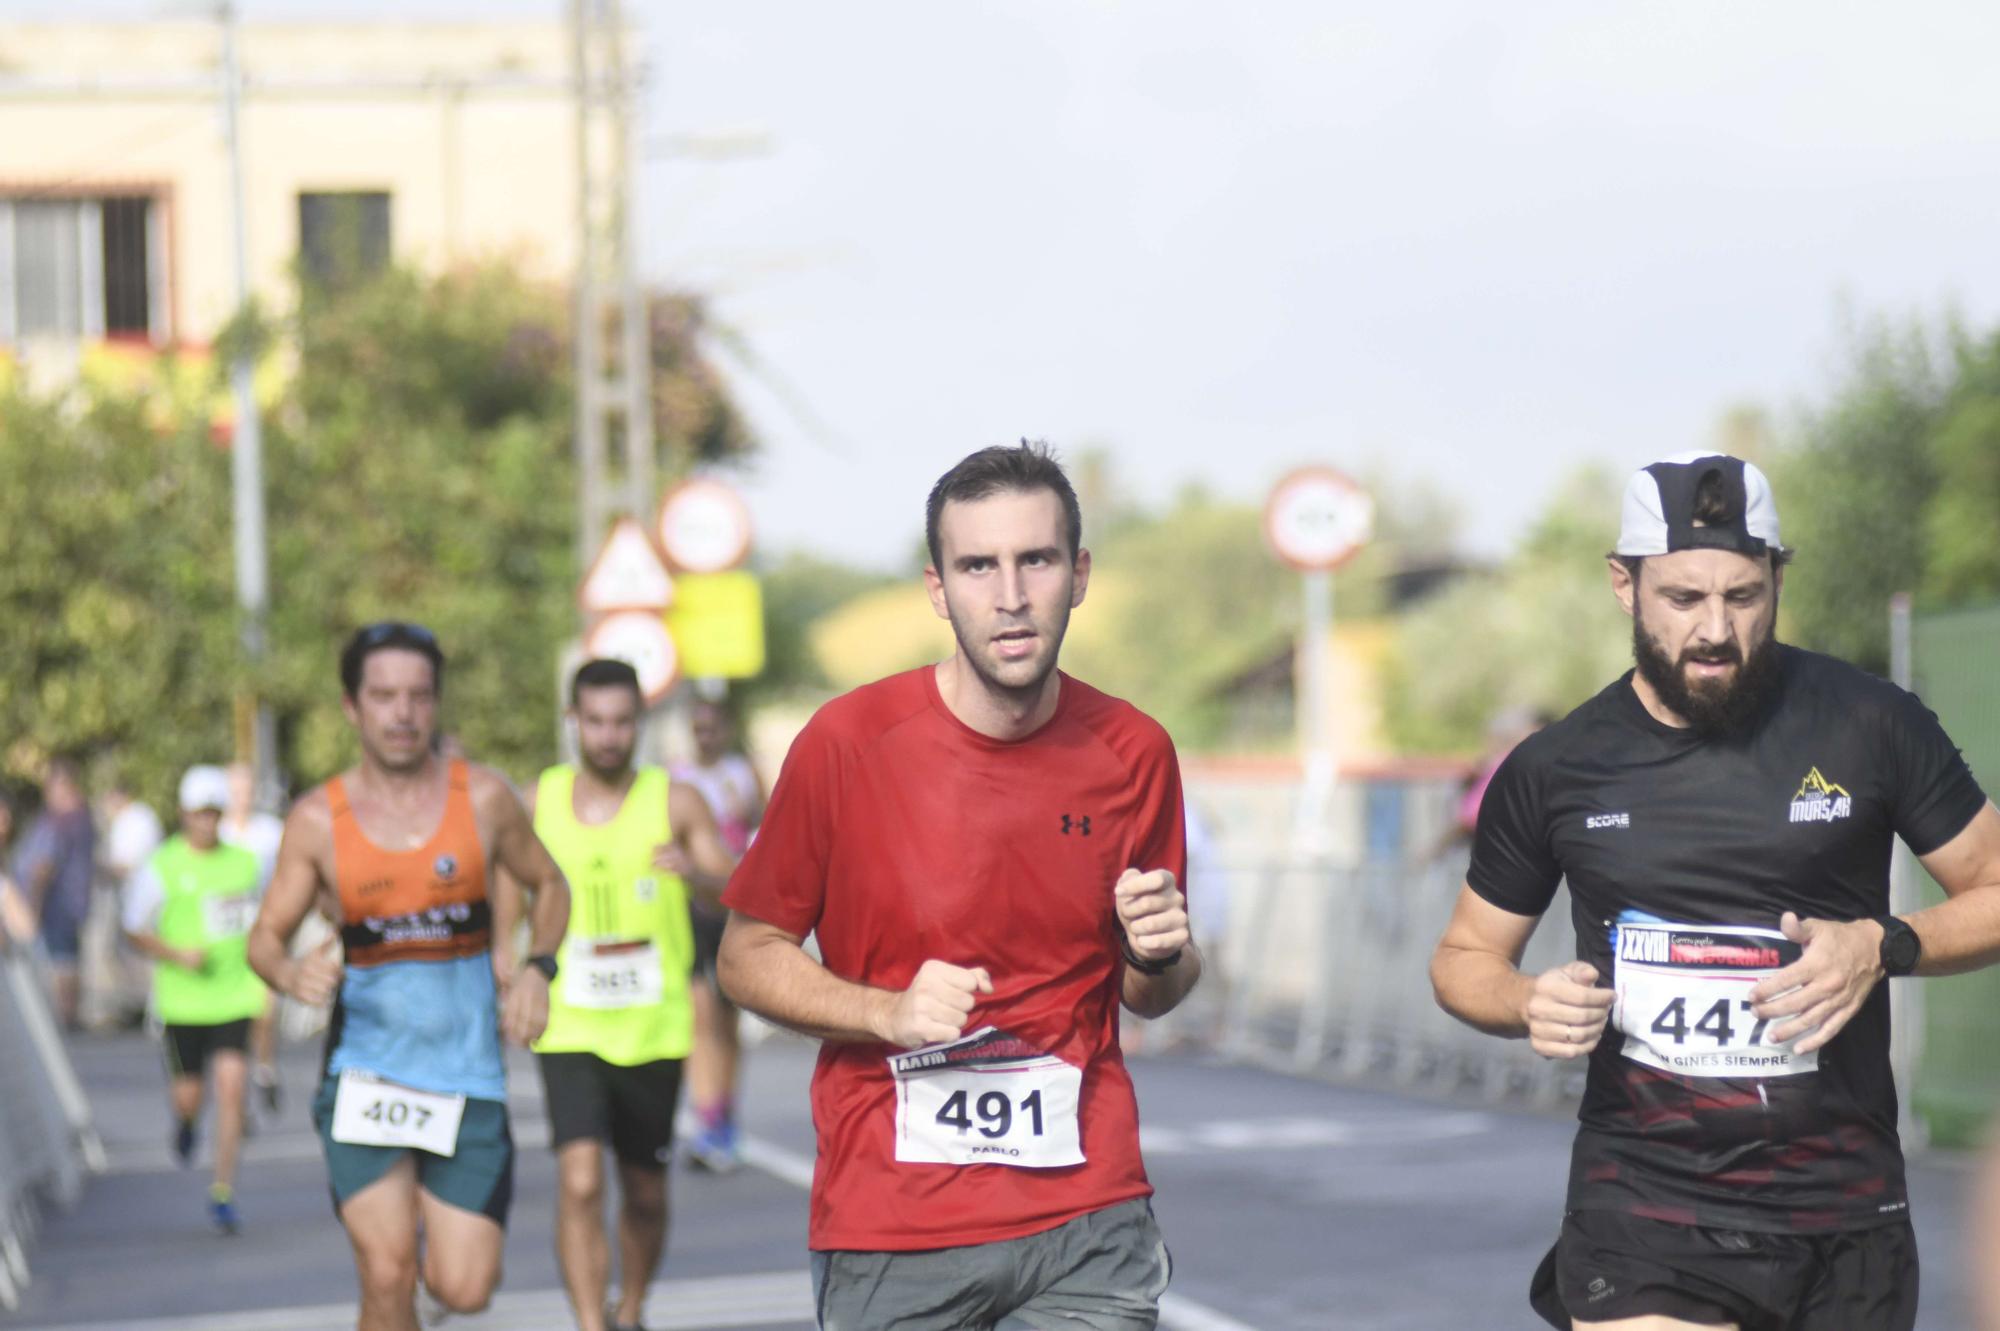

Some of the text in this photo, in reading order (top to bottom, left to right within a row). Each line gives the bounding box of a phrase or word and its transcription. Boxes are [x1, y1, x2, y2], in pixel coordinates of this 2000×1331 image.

[1586, 813, 1630, 828] SCORE
[1622, 928, 1669, 962] XXVIII
[1674, 1055, 1719, 1067] GINES
[1724, 1054, 1789, 1067] SIEMPRE
[362, 1100, 432, 1130] 407
[935, 1089, 1043, 1139] 491
[972, 1146, 1020, 1157] PABLO
